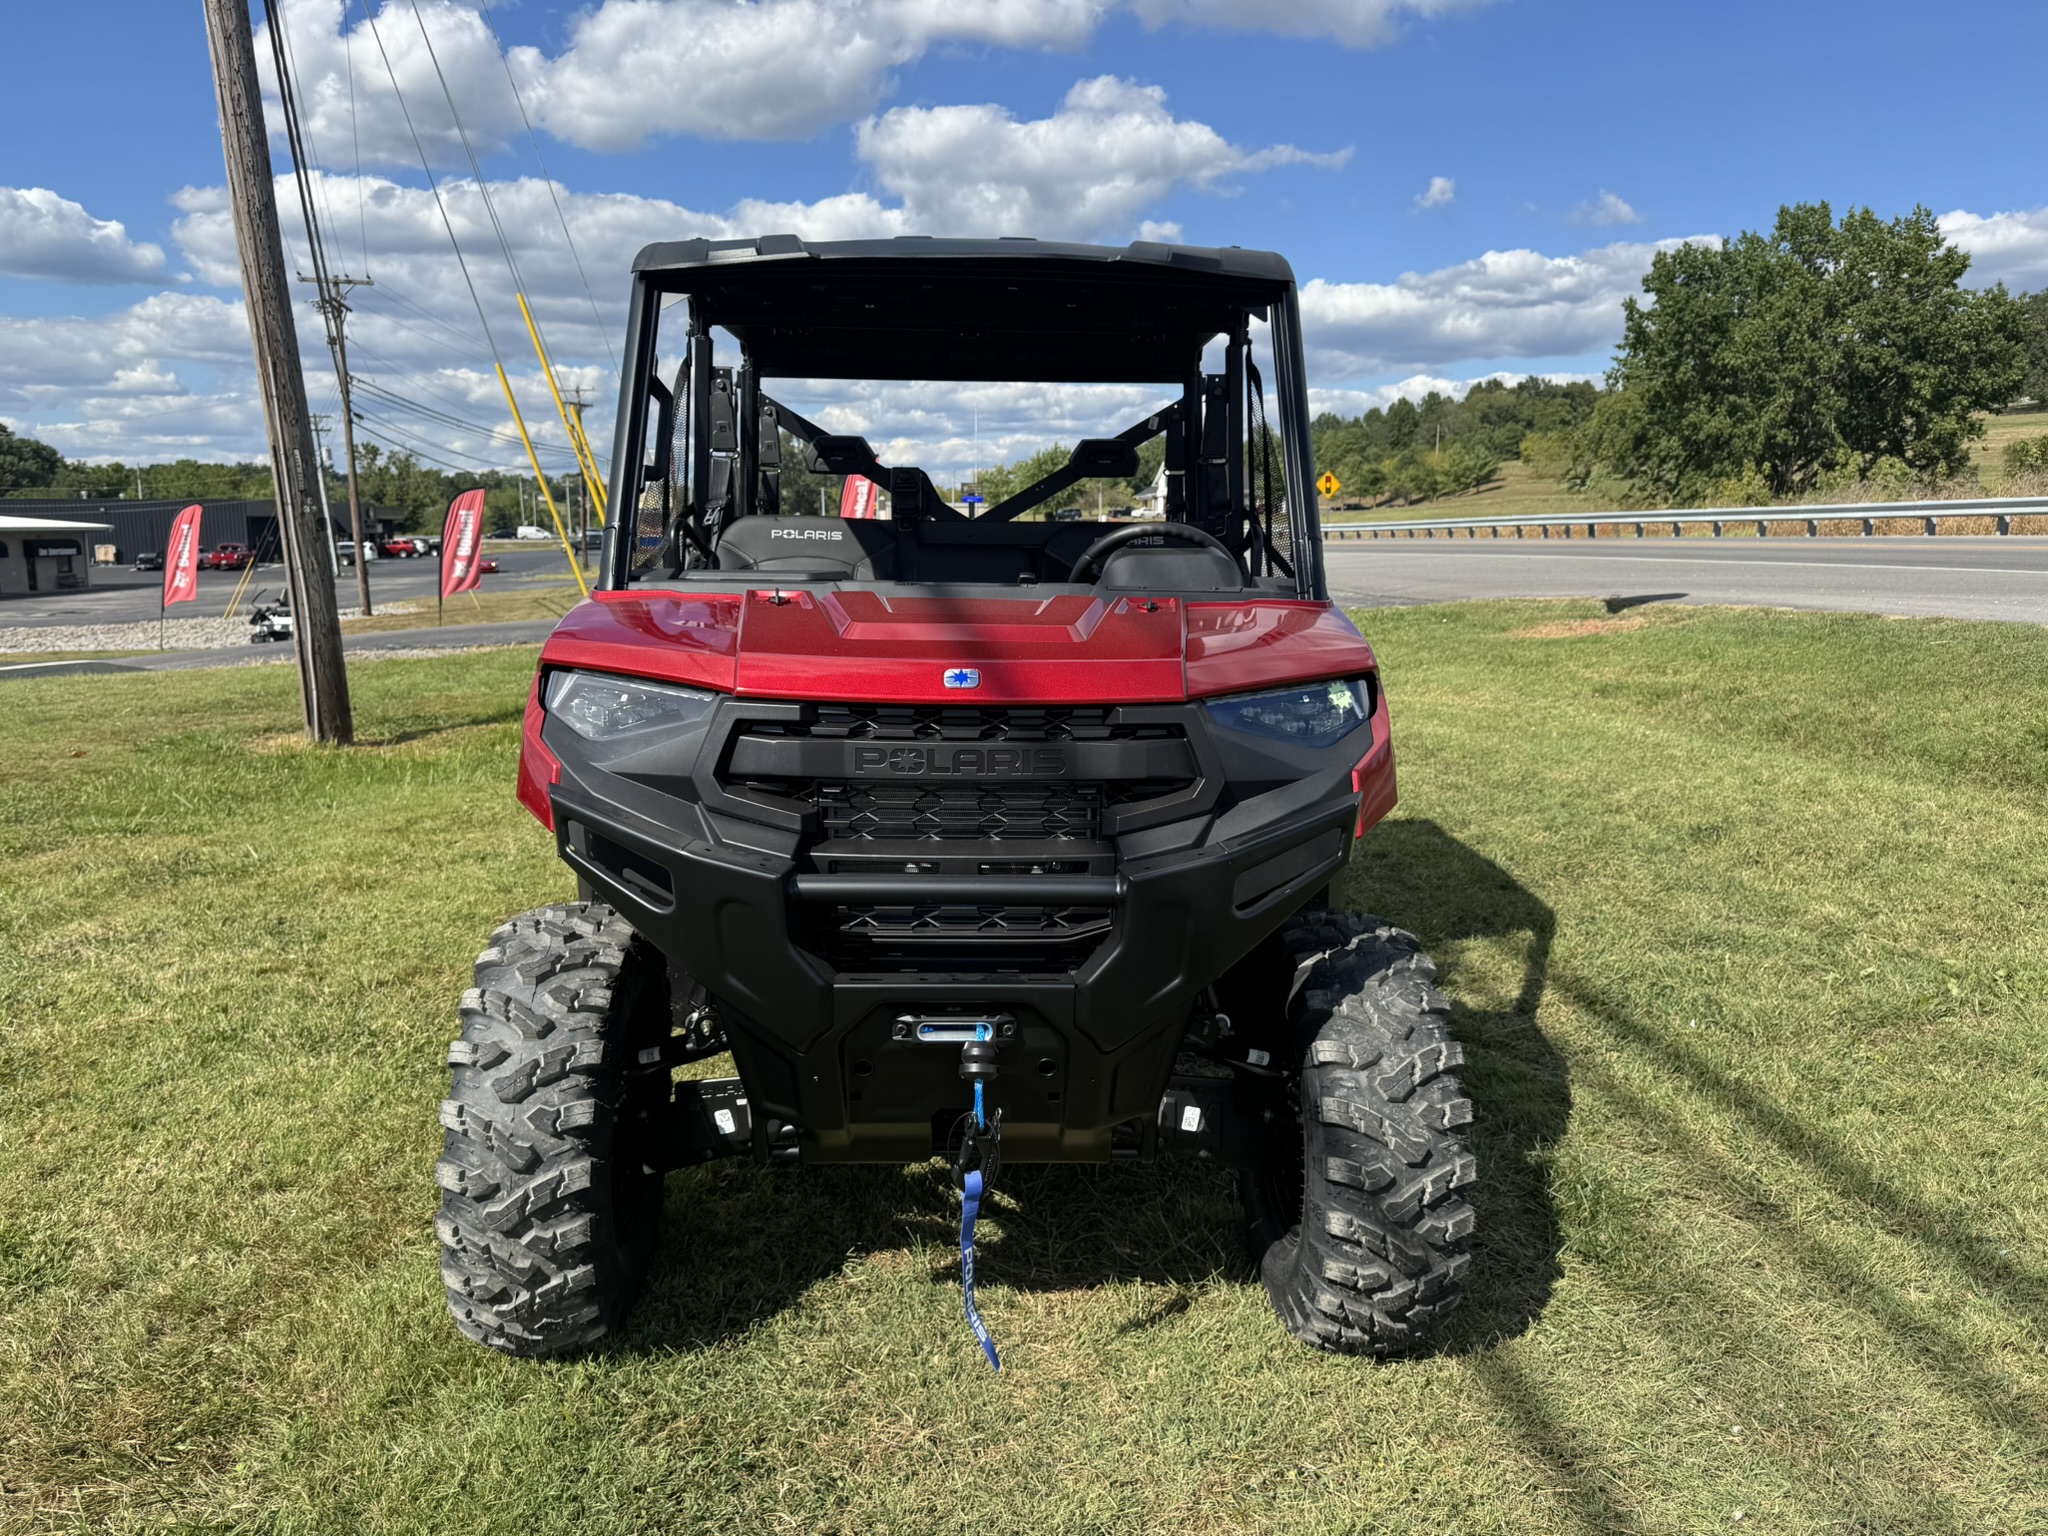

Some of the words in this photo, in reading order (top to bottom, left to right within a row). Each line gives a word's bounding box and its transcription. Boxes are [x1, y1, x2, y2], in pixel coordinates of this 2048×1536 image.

[771, 529, 843, 541] POLARIS
[1094, 536, 1165, 546] PARIS
[854, 747, 1067, 776] POLARIS
[963, 1246, 988, 1344] POLARIS
